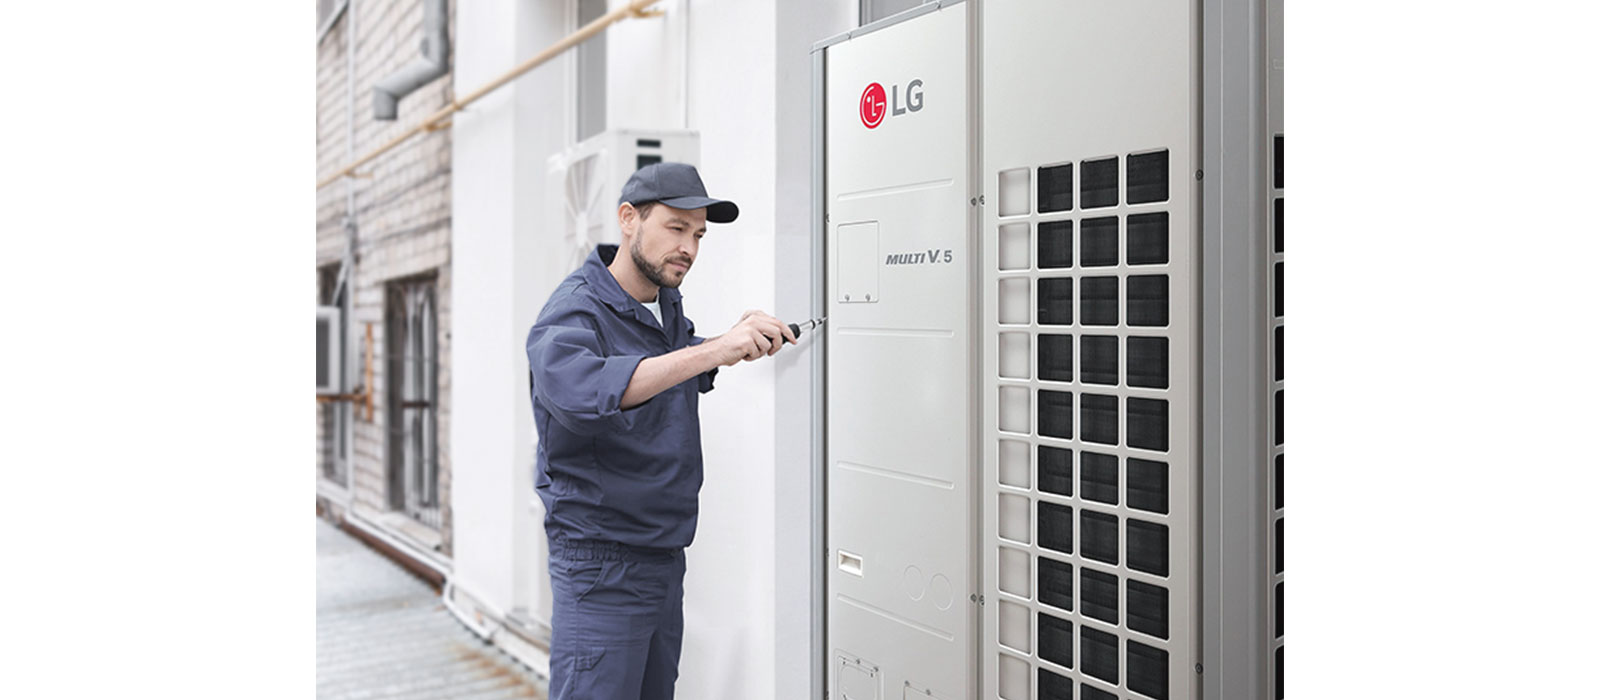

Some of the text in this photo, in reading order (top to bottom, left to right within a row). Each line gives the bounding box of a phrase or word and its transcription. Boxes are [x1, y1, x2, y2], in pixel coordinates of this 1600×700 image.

[892, 79, 923, 116] LG
[885, 253, 926, 265] MULTI
[943, 250, 953, 263] 5
